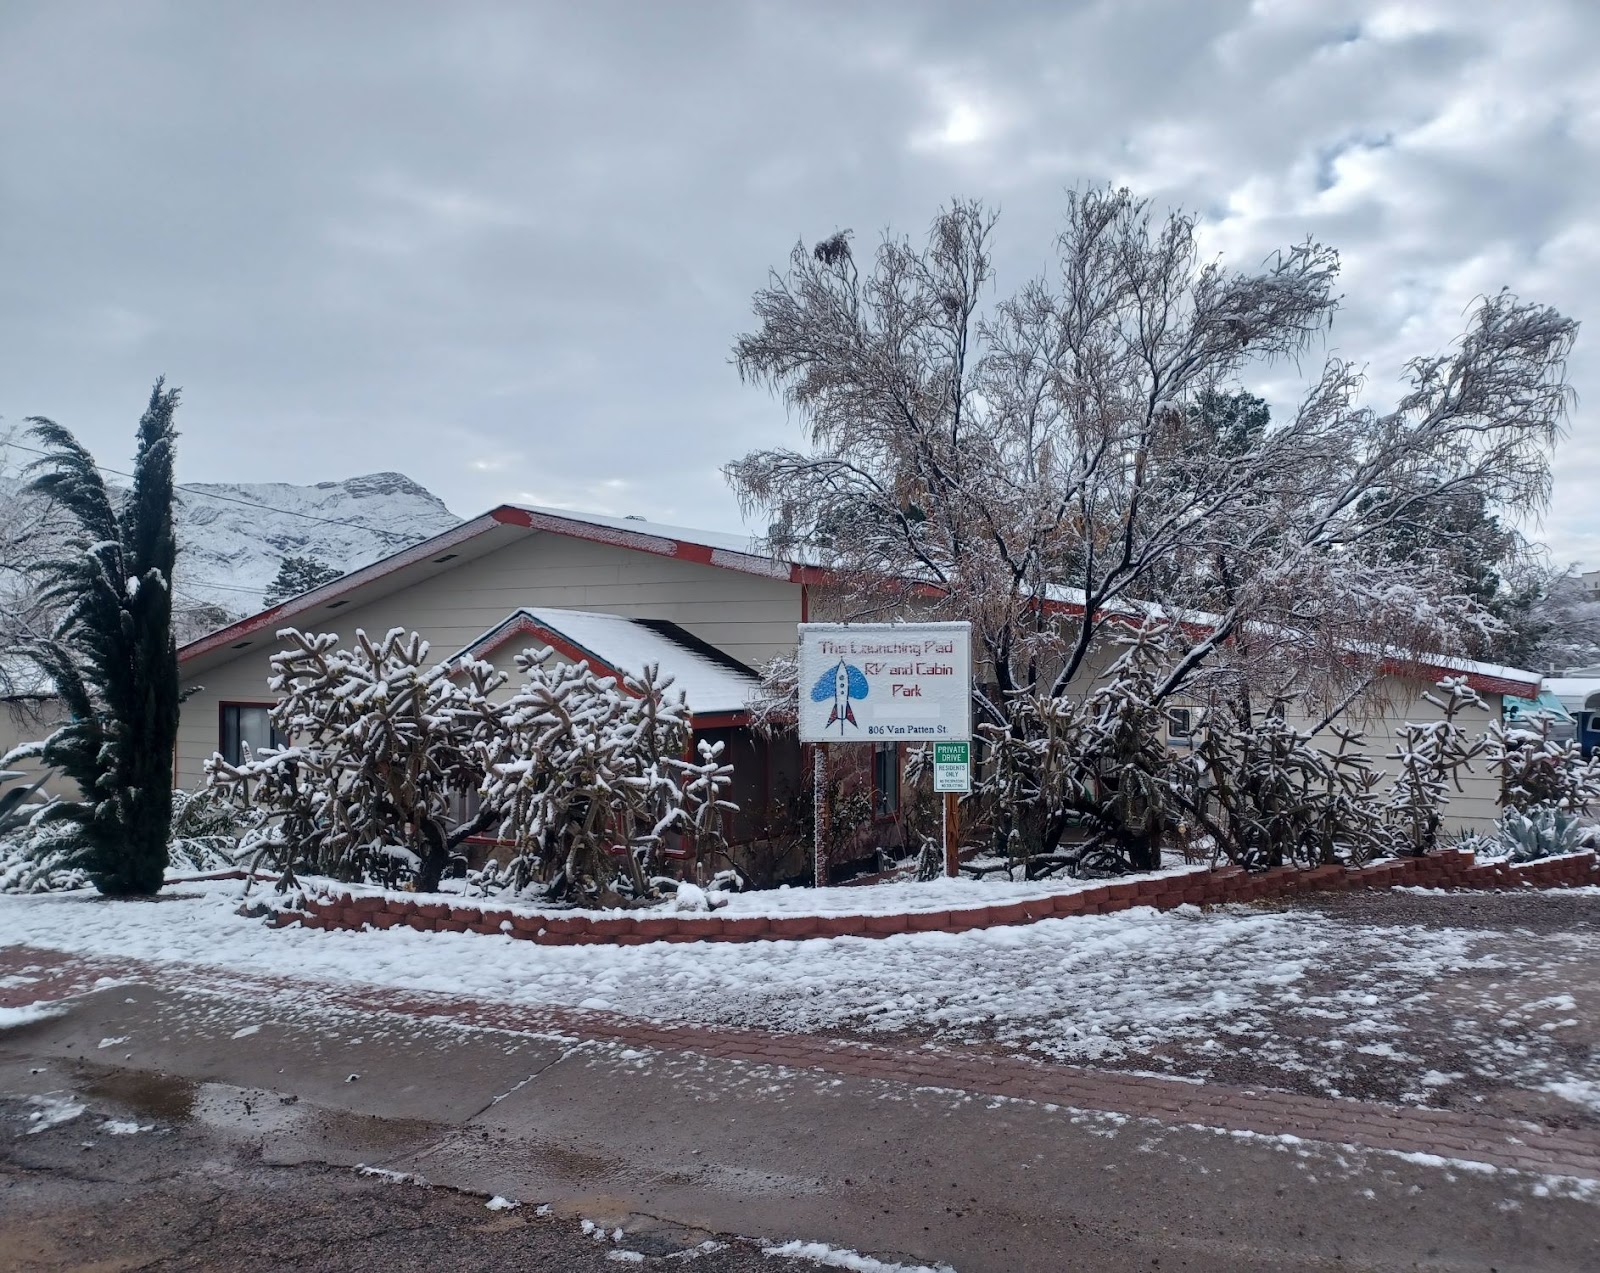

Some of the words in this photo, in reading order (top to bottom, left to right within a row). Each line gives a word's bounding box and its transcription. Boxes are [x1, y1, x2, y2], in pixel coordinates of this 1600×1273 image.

[819, 641, 847, 654] The
[924, 640, 953, 654] Pad
[864, 662, 887, 676] RV
[889, 663, 913, 676] and
[916, 662, 953, 676] Cabin
[892, 684, 922, 697] Park
[868, 725, 884, 734] 806
[886, 725, 905, 734] Van
[907, 725, 934, 734] Patten
[942, 754, 961, 762] DRIVE
